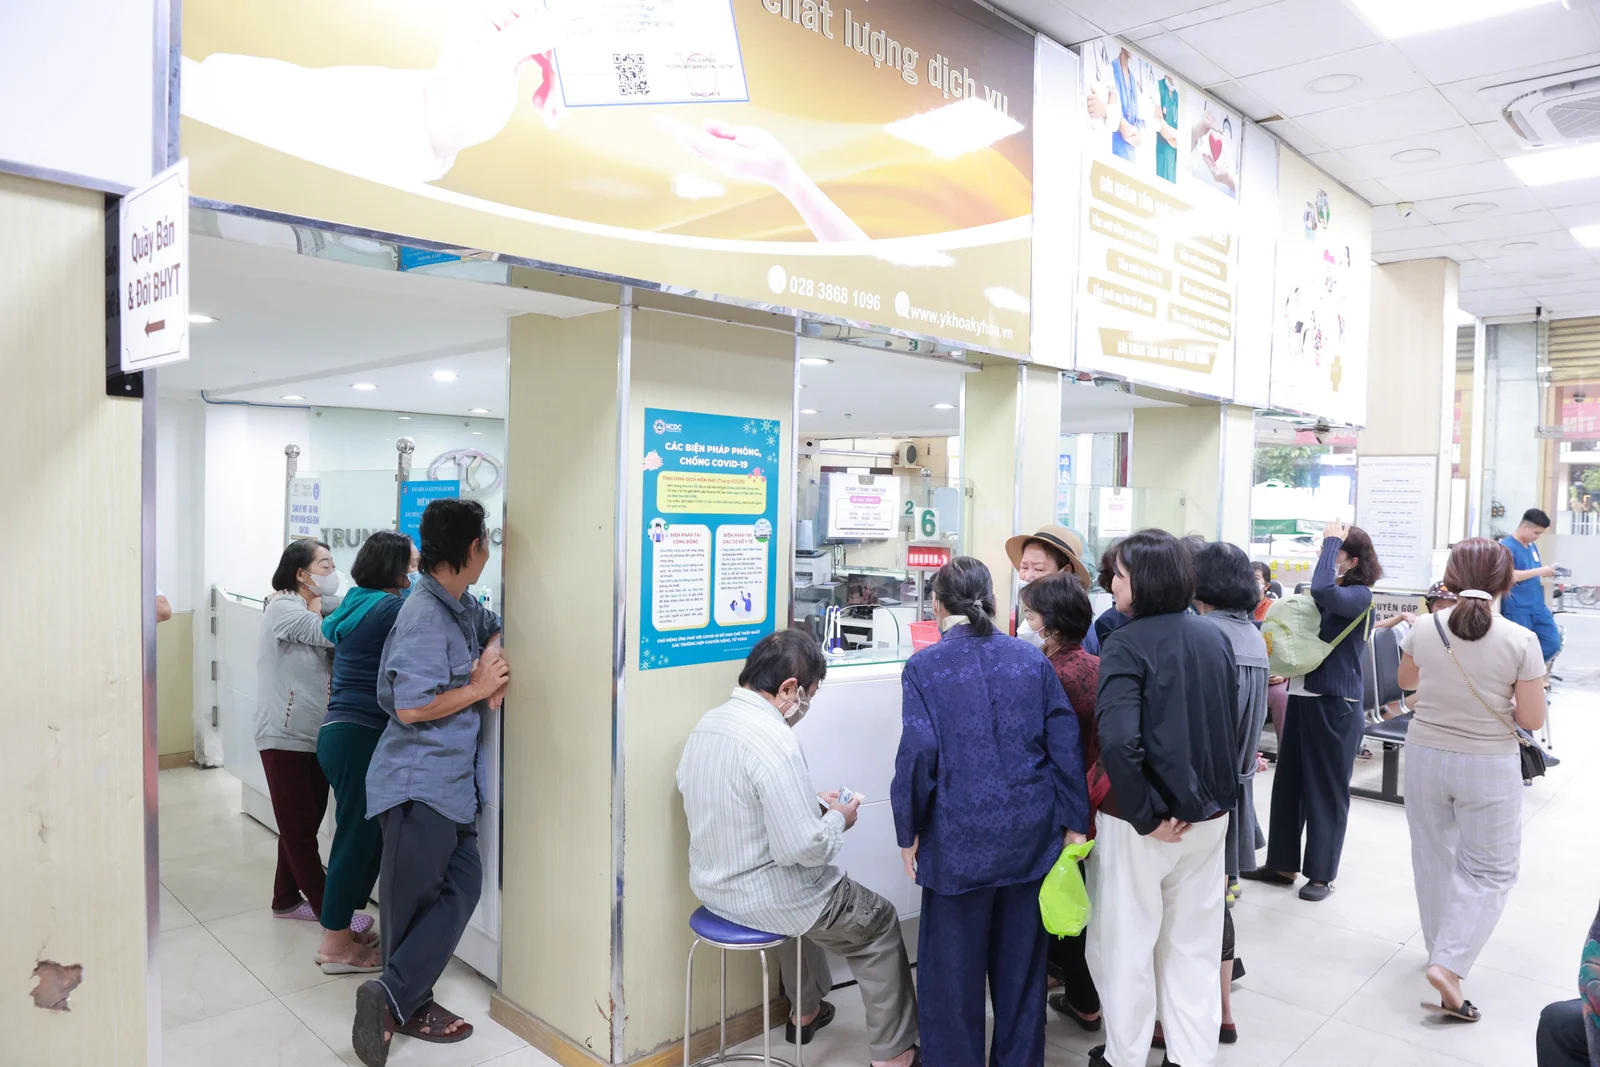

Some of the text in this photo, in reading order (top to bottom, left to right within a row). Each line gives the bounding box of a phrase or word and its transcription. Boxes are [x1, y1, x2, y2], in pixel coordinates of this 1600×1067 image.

[844, 8, 918, 85] lượng
[928, 53, 976, 101] dịch
[131, 214, 175, 264] Quầy Bán
[128, 262, 181, 310] & Đổi BHYT
[789, 275, 881, 311] 028 3868 1096
[910, 306, 1013, 340] www.ykhoakyhoa.vn
[665, 423, 682, 431] HCDC
[665, 441, 762, 457] CÁC BIỆN PHÁP PHÒNG,
[680, 455, 748, 469] CHỐNG COVID-19
[904, 500, 914, 515] 2
[921, 509, 936, 537] 6
[1375, 602, 1418, 613] UYÊN GÓP
